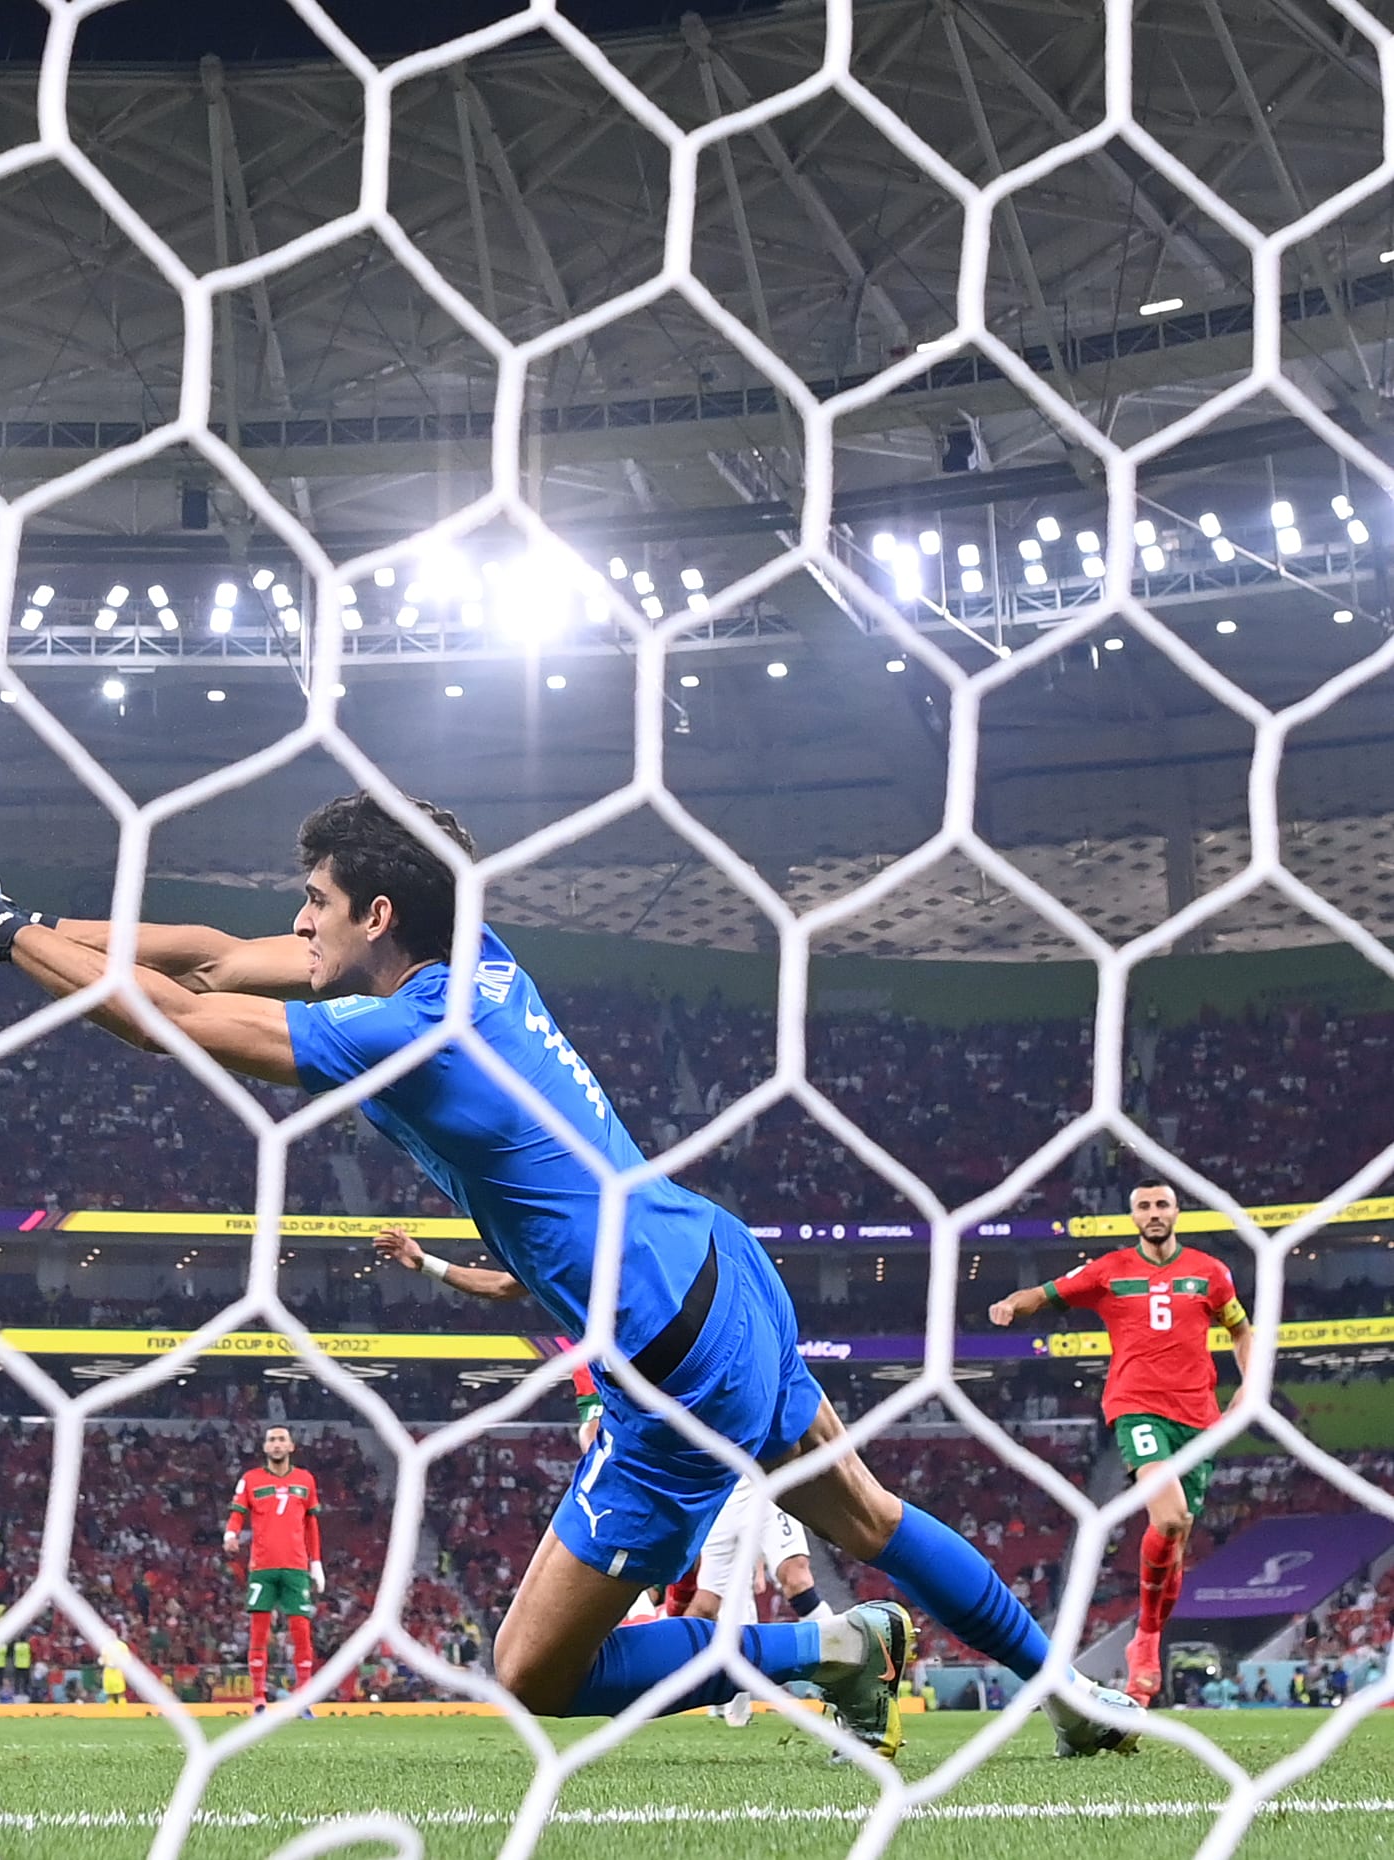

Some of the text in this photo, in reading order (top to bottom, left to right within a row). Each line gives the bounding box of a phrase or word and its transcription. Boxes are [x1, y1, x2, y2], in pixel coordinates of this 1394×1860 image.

[225, 1219, 252, 1230] FIFA
[301, 1221, 325, 1231] CUP
[799, 1224, 813, 1239] 0
[832, 1224, 846, 1239] 0
[1149, 1294, 1172, 1331] 6
[147, 1337, 177, 1349] FIFA
[234, 1338, 261, 1350] CUP
[1131, 1423, 1158, 1457] 6
[275, 1493, 289, 1516] 7
[777, 1511, 793, 1537] 3
[248, 1582, 263, 1606] 7
